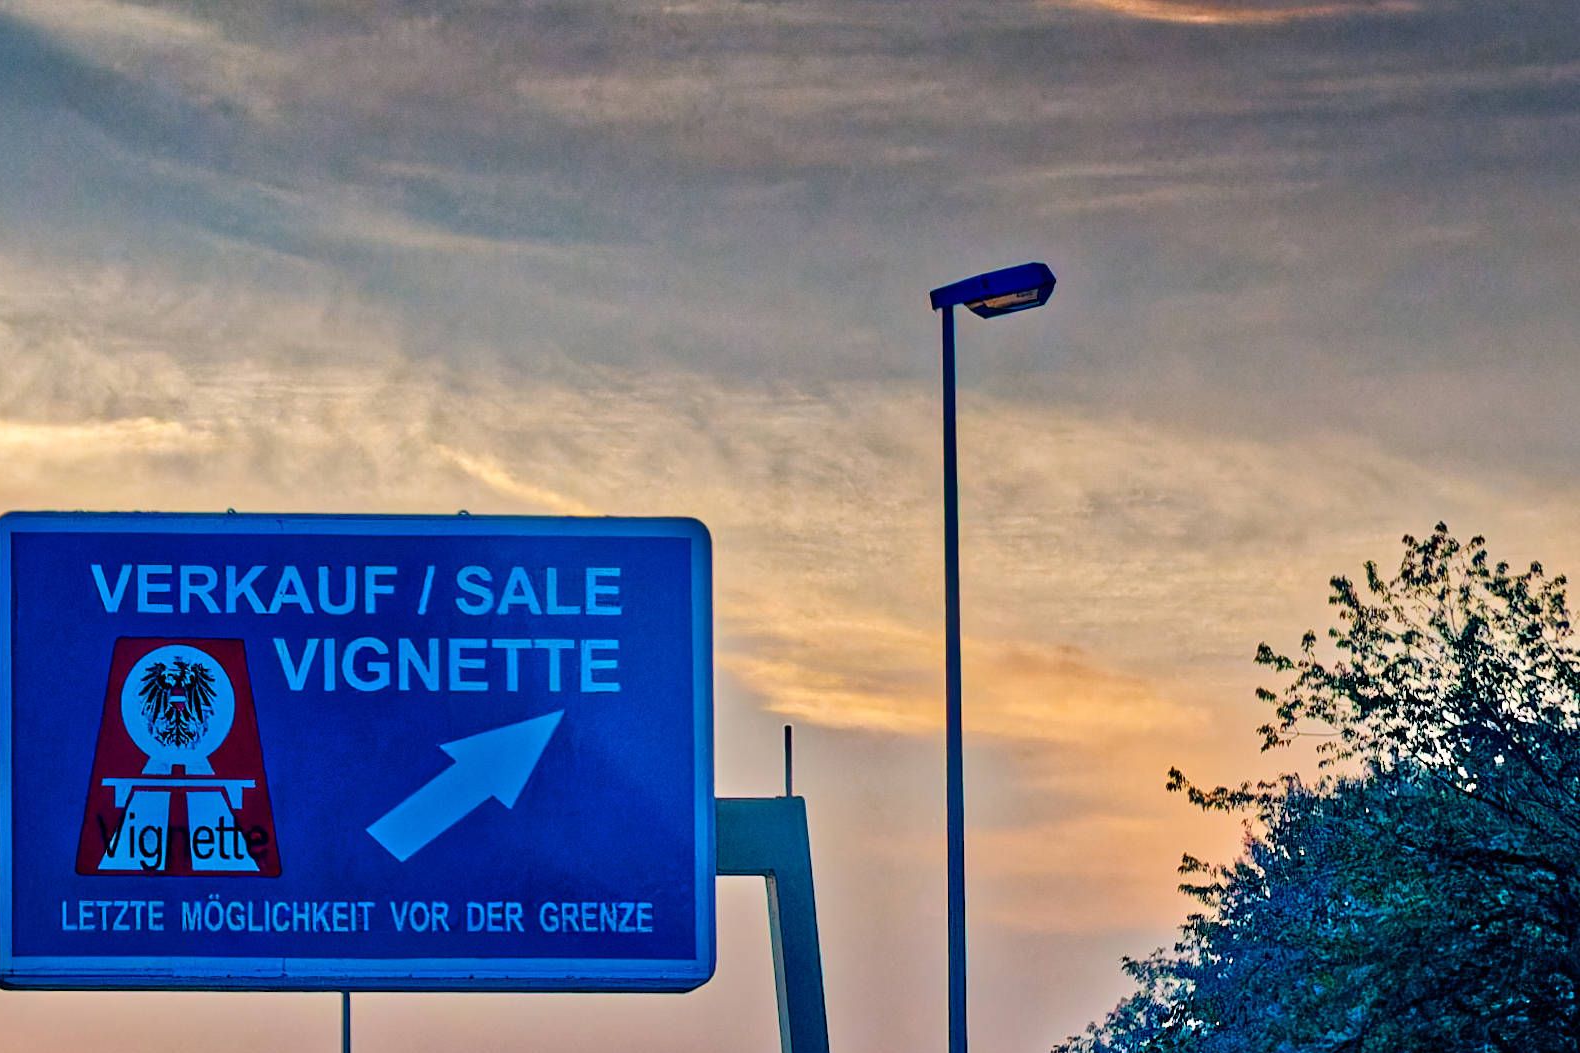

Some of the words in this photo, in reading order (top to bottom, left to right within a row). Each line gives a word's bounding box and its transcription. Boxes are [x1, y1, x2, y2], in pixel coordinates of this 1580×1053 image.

[91, 563, 398, 615] VERKAUF
[416, 564, 435, 615] /
[454, 566, 623, 617] SALE
[272, 636, 622, 693] VIGNETTE
[96, 811, 269, 871] Vignette
[60, 899, 165, 932] LETZTE
[181, 892, 376, 934] MÖGLICHKEIT
[390, 900, 450, 933] VOR
[466, 901, 524, 934] DER
[539, 901, 655, 934] GRENZE
